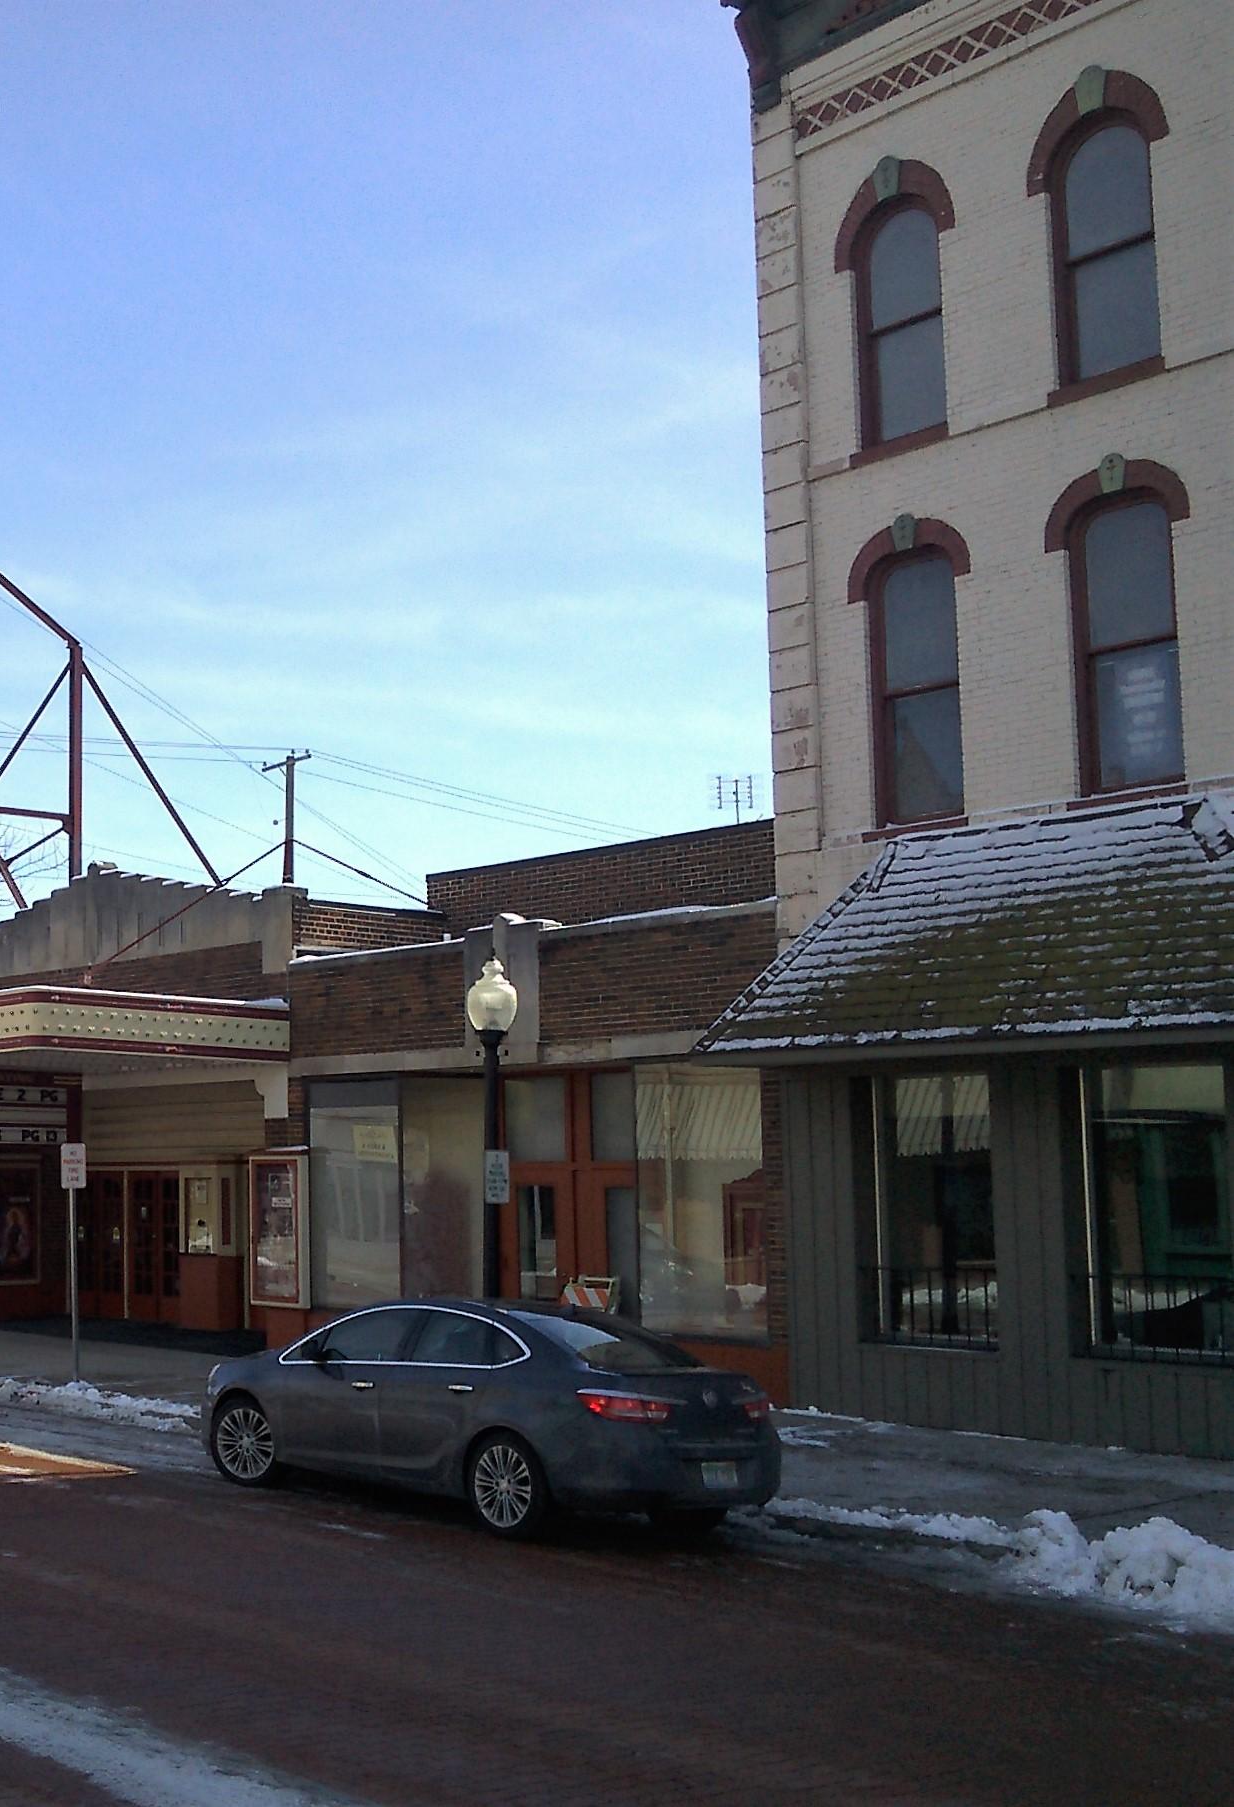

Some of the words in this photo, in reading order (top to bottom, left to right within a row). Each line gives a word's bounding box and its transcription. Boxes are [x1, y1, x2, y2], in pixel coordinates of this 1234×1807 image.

[17, 1088, 26, 1100] 2
[40, 1089, 59, 1102] PG
[21, 1129, 40, 1142] PG
